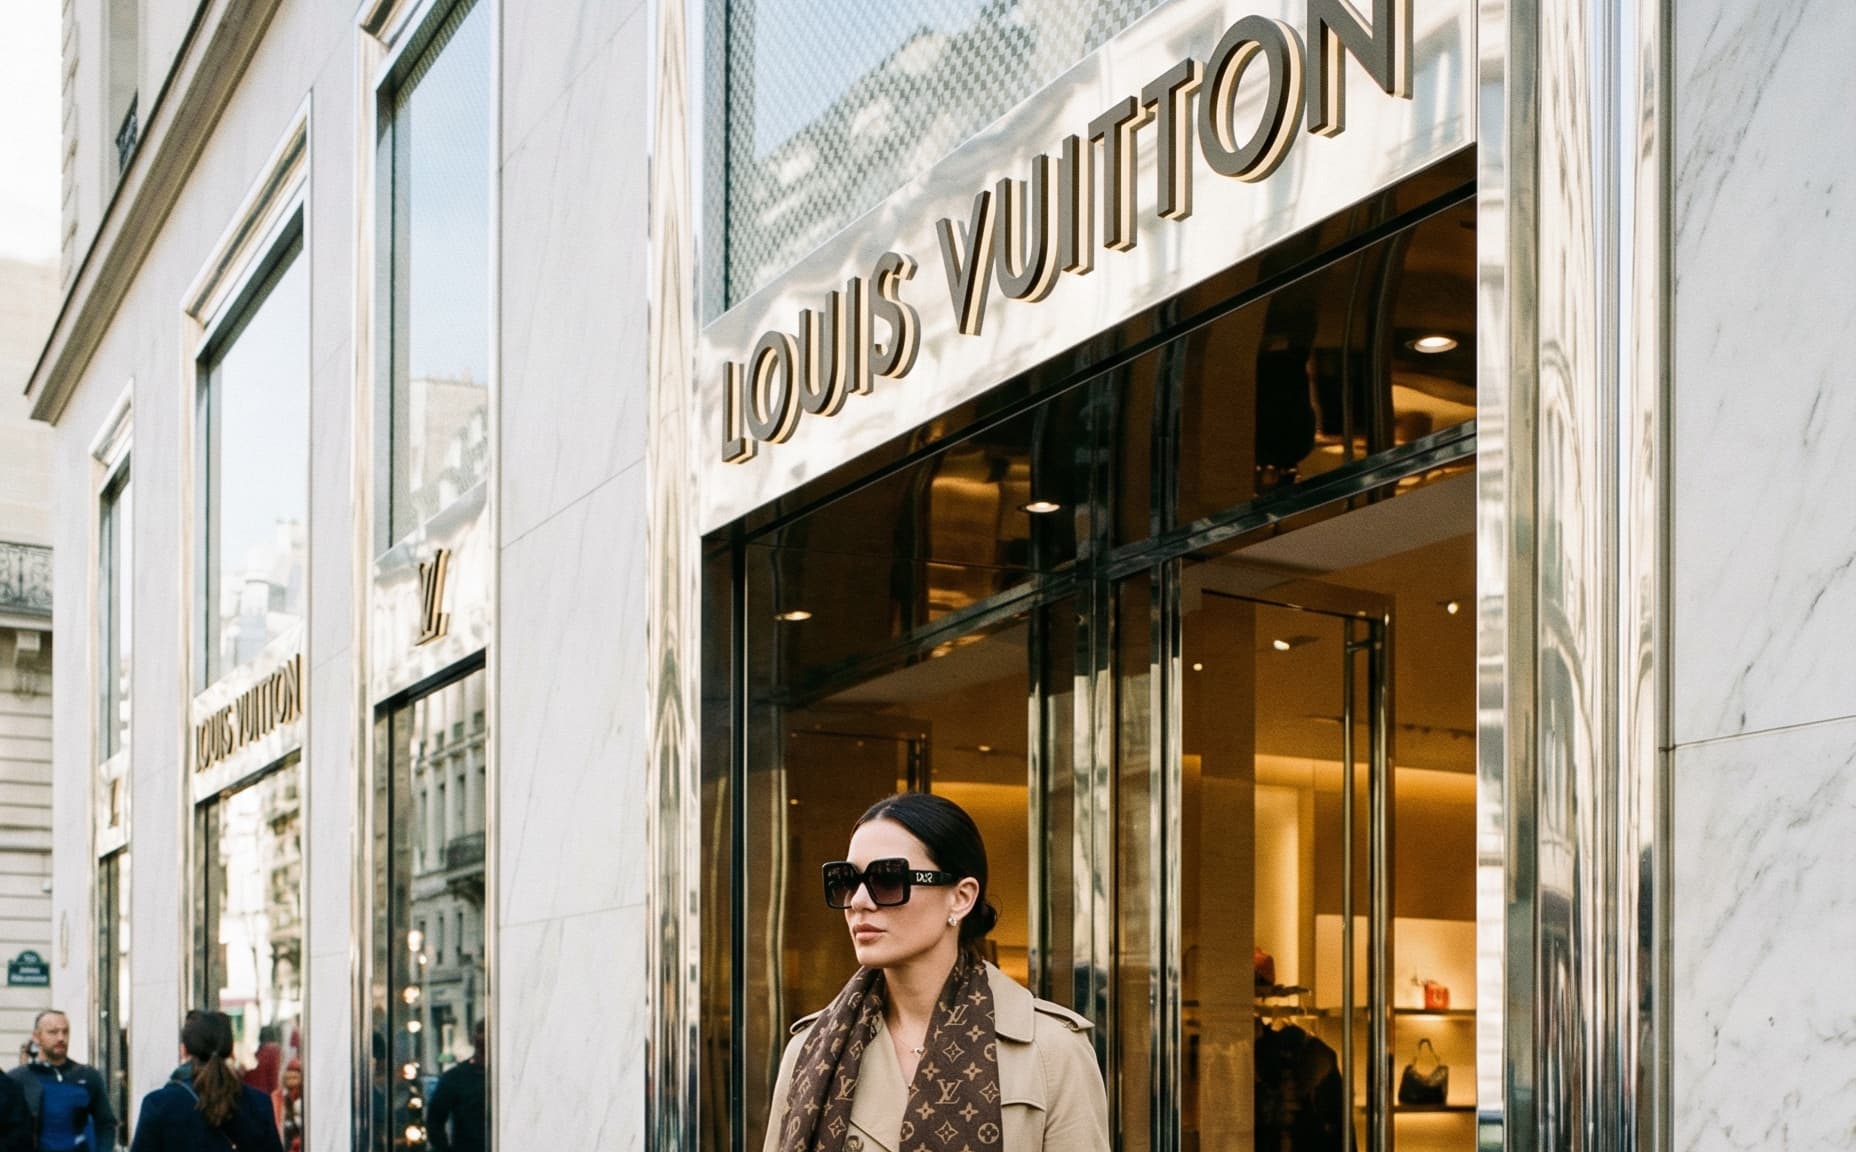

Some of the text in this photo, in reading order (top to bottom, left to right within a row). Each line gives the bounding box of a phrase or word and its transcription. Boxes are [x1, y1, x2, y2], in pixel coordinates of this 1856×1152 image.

[722, 0, 1414, 465] LOUIS VUITTON
[196, 653, 302, 774] LOUIS VUITTON
[935, 1079, 963, 1104] LV
